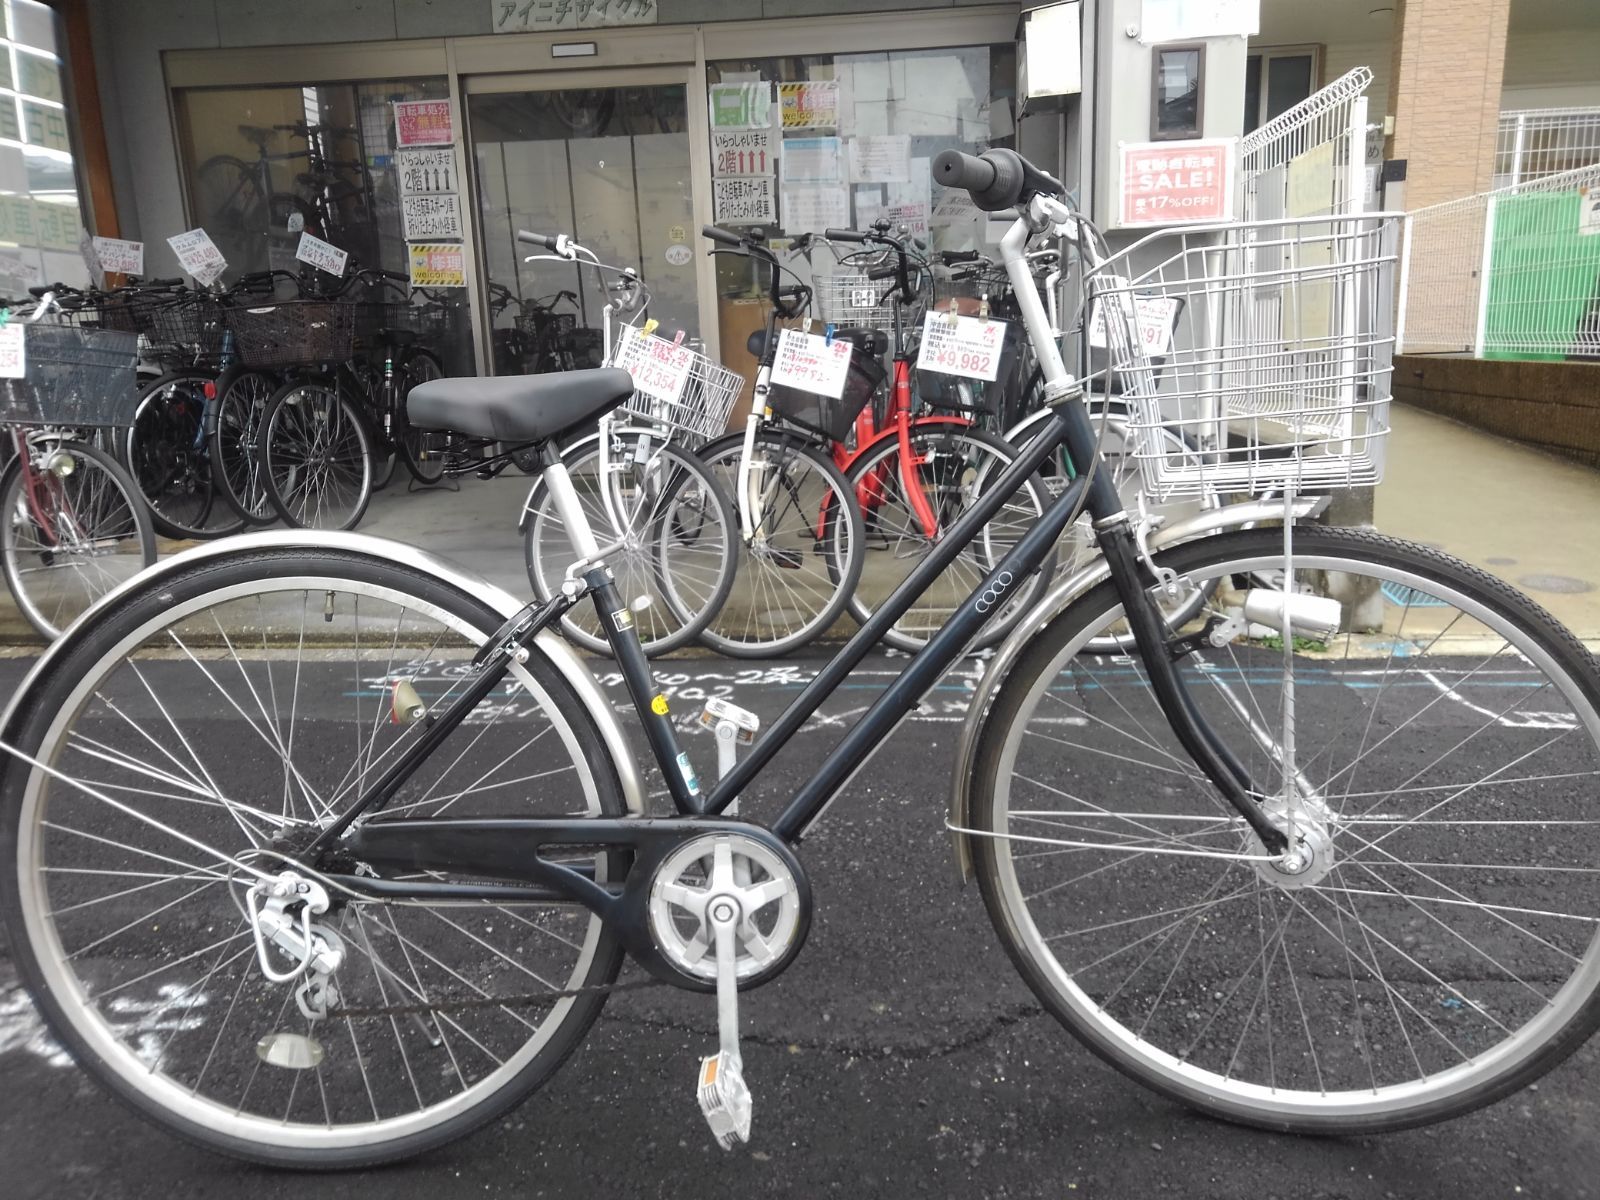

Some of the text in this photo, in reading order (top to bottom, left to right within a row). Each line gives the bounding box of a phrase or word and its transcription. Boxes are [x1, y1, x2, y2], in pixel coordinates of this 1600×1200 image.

[715, 132, 768, 148] いらっしゃいませ
[399, 151, 452, 166] いらっしゃいませ
[718, 150, 737, 174] 2階
[404, 168, 423, 191] 2階
[1139, 171, 1214, 192] SALE!
[937, 349, 990, 374] ¥9,982
[630, 362, 678, 392] ¥12,354
